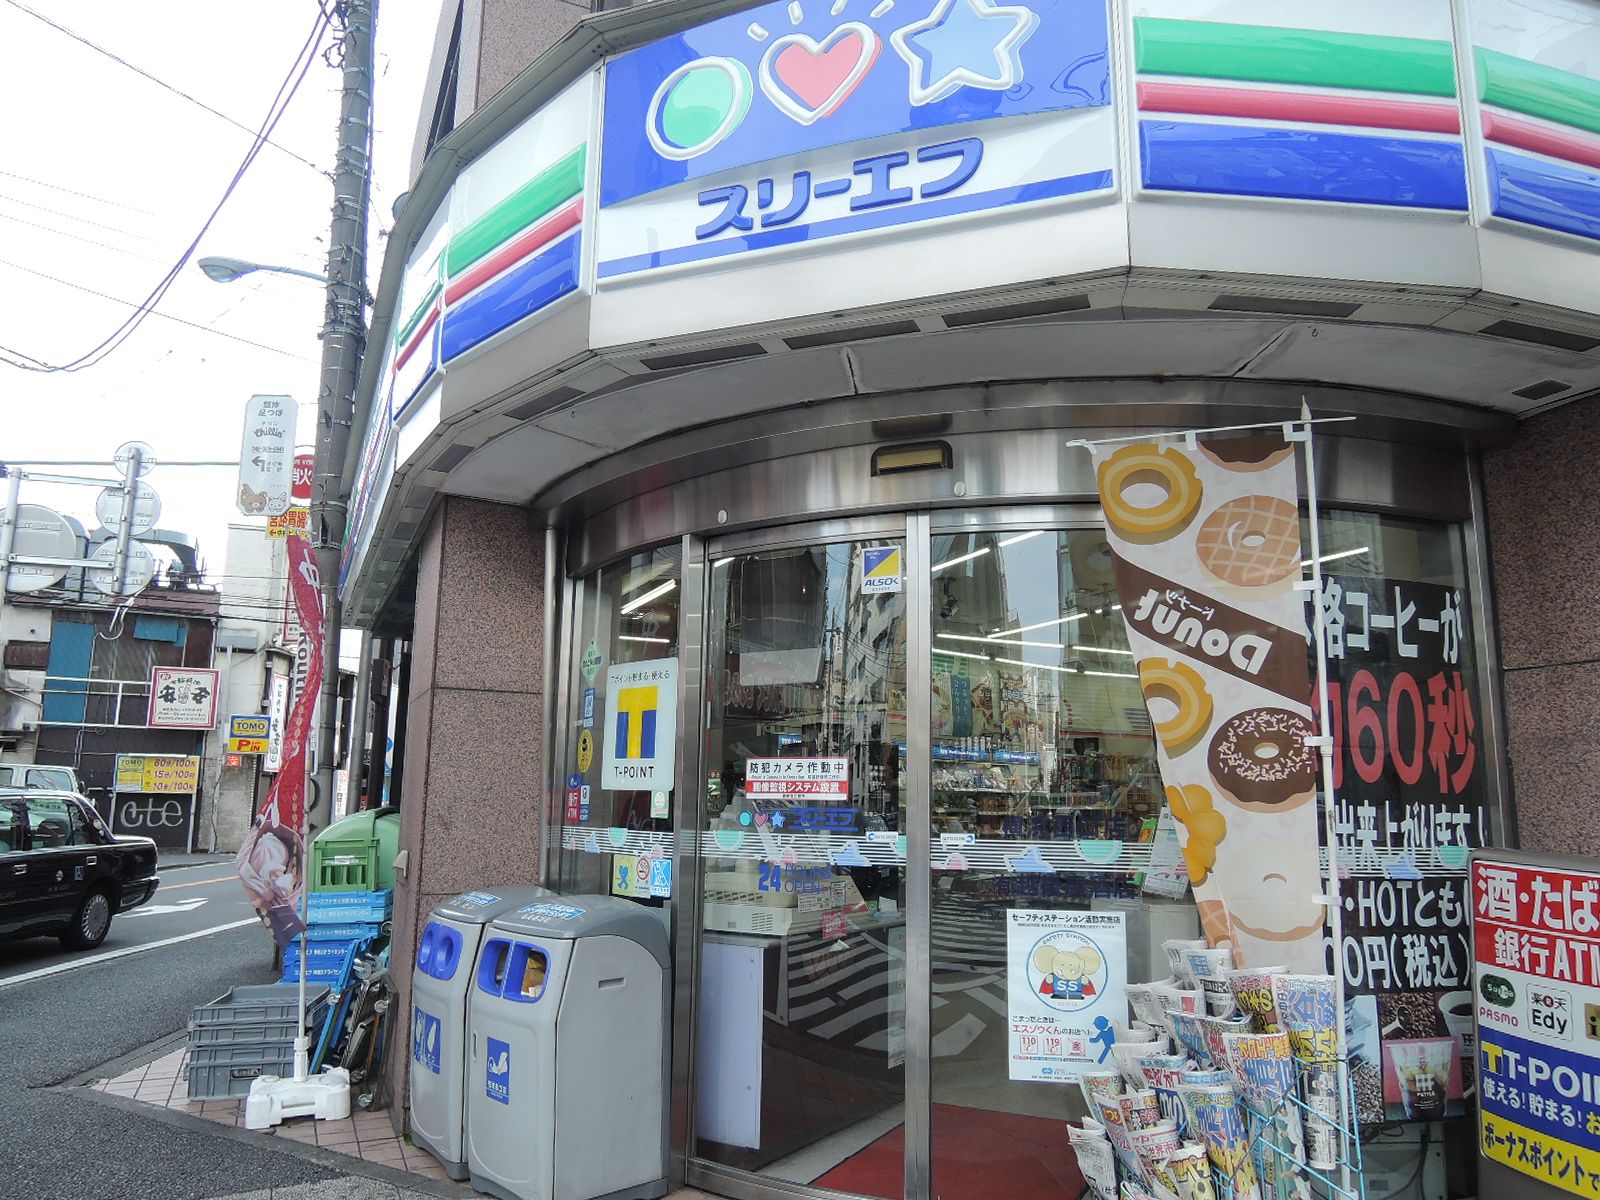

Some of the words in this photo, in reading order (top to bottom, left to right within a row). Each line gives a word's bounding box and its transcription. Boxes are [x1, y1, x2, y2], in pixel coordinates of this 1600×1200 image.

[696, 137, 984, 240] スリーエフ
[865, 577, 899, 587] ALSOK
[1302, 577, 1463, 664] 格コーヒーが
[236, 722, 265, 730] TOMO
[614, 766, 655, 779] T-POINT
[750, 761, 844, 774] 防犯カメラ作動中
[752, 781, 840, 793] 画像監視システム設置
[758, 863, 781, 892] 24
[784, 880, 821, 895] OPEN
[1056, 980, 1079, 992] SS
[1487, 983, 1515, 999] Suica
[1479, 1006, 1519, 1027] PASMO
[1531, 1008, 1568, 1034] Edy
[1022, 1036, 1036, 1046] 110
[1046, 1038, 1060, 1047] 119
